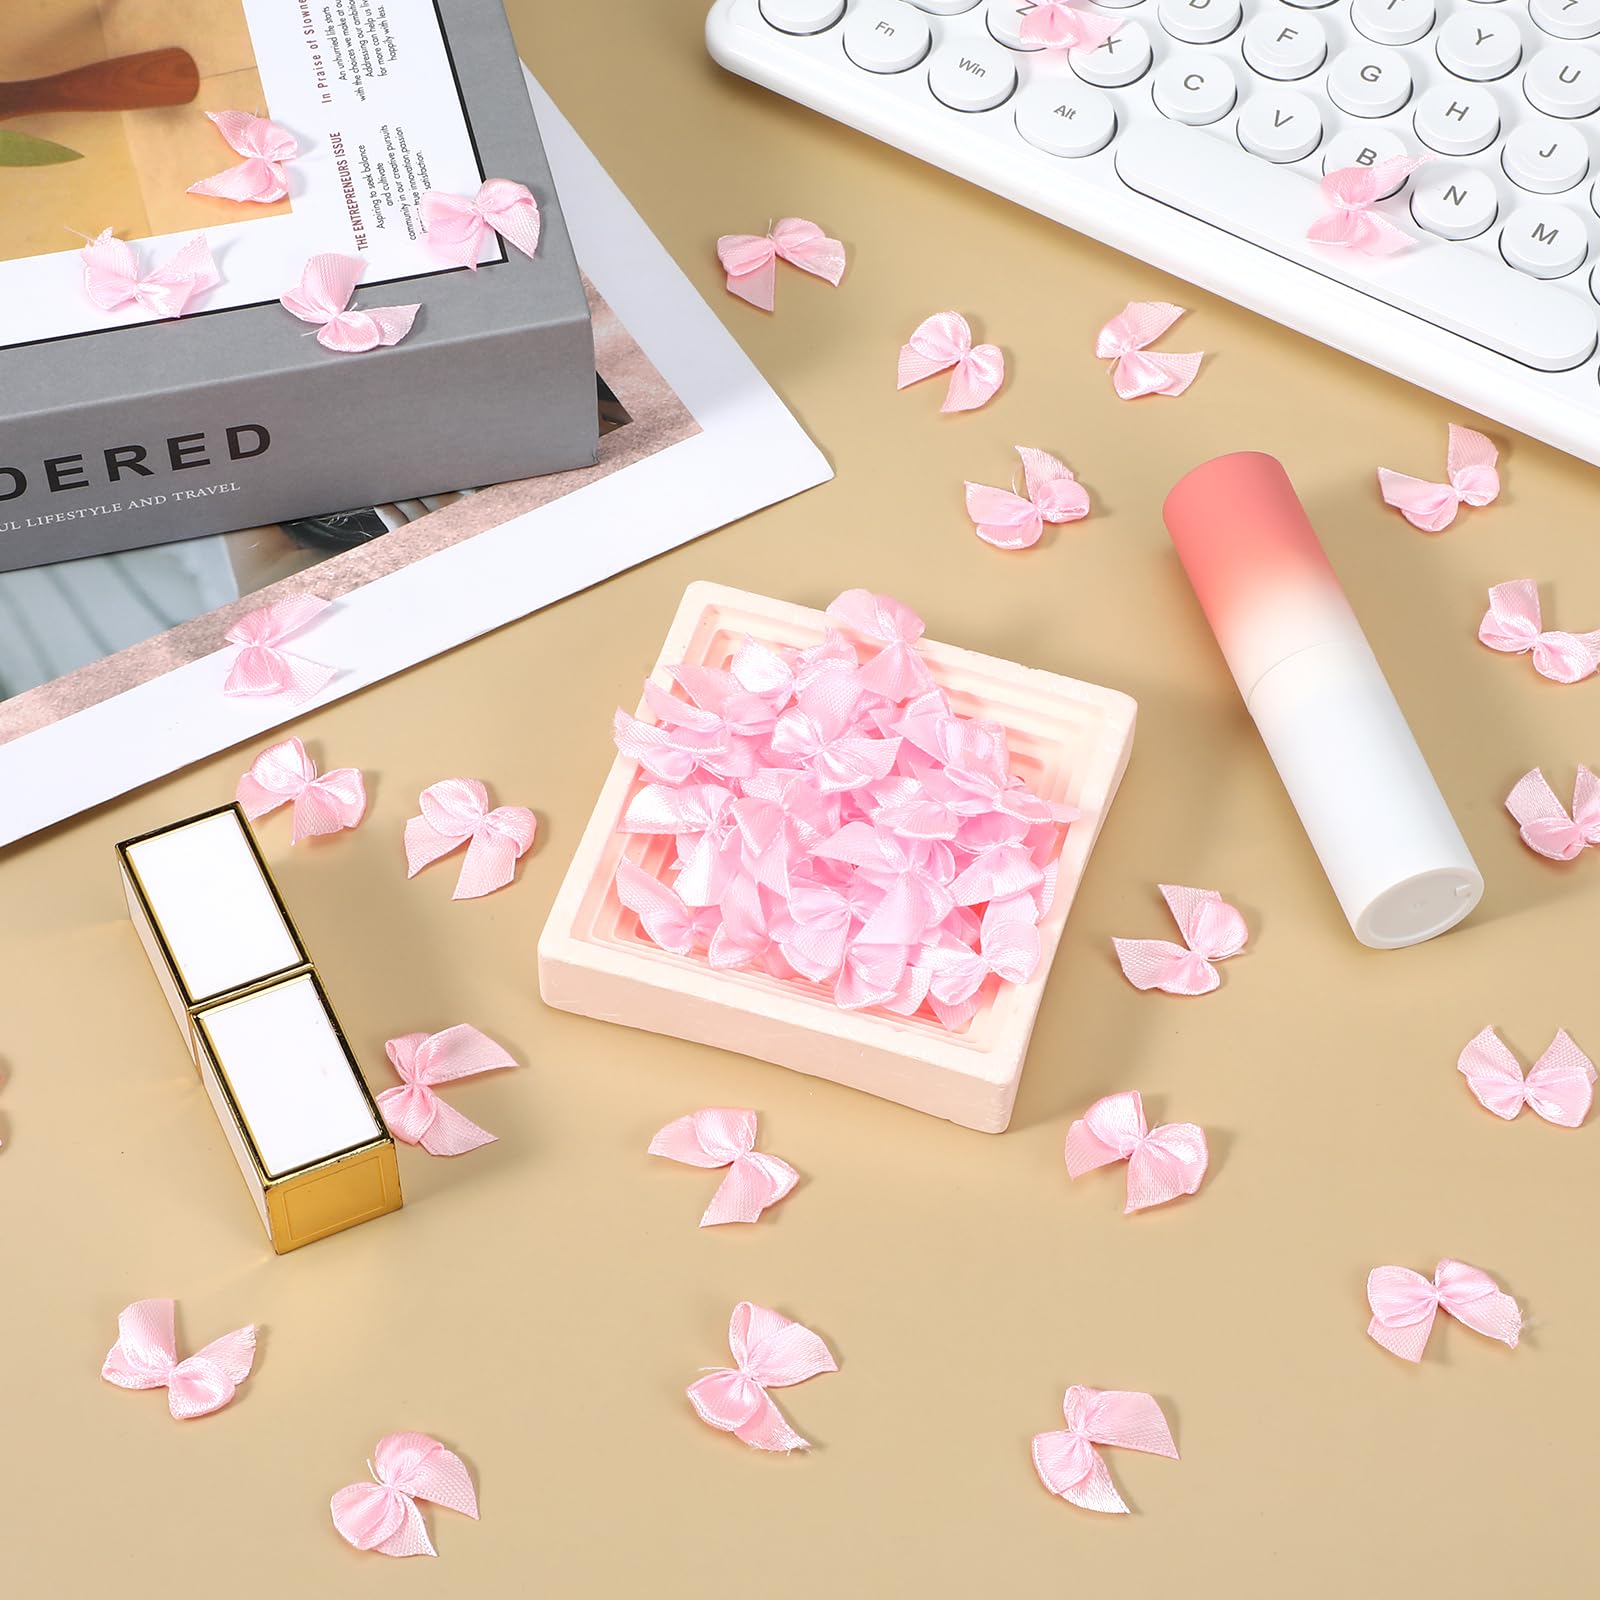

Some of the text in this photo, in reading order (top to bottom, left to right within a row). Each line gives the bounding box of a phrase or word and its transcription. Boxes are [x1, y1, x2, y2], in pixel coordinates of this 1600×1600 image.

[336, 9, 345, 17] at
[364, 8, 373, 17] us
[337, 17, 350, 37] make
[355, 27, 365, 39] our
[363, 17, 377, 34] help
[375, 4, 398, 62] happily with less.
[874, 21, 895, 37] Fn
[1276, 27, 1299, 42] F
[306, 39, 319, 50] of
[322, 6, 348, 81] An unhurried life starts
[344, 37, 353, 48] we
[371, 33, 380, 47] can
[1097, 35, 1122, 55] X
[1475, 28, 1494, 46] Y
[347, 48, 360, 74] choices
[358, 39, 375, 78] Addressing
[374, 47, 385, 66] more
[312, 54, 329, 89] Praise
[377, 66, 388, 77] for
[958, 57, 986, 78] Win
[1360, 64, 1382, 83] G
[1558, 65, 1582, 84] U
[351, 74, 363, 86] the
[1183, 74, 1205, 91] C
[321, 92, 333, 104] In
[353, 86, 367, 102] with
[1053, 104, 1076, 120] Alt
[1274, 109, 1294, 128] V
[1445, 101, 1470, 122] H
[1355, 147, 1378, 167] B
[1538, 143, 1558, 158] J
[415, 149, 432, 190] satisfaction.
[329, 131, 369, 252] THE ENTREPRENEURS ISSUE
[358, 144, 386, 230] Aspiring to seek balance
[376, 162, 394, 207] and cultivate
[379, 124, 417, 241] community in our creative pursuits
[412, 191, 421, 206] true
[1442, 185, 1468, 206] N
[1531, 222, 1560, 245] M
[25, 502, 122, 528] LIFESTYLE
[128, 495, 167, 510] AND
[171, 482, 241, 501] TRAVEL
